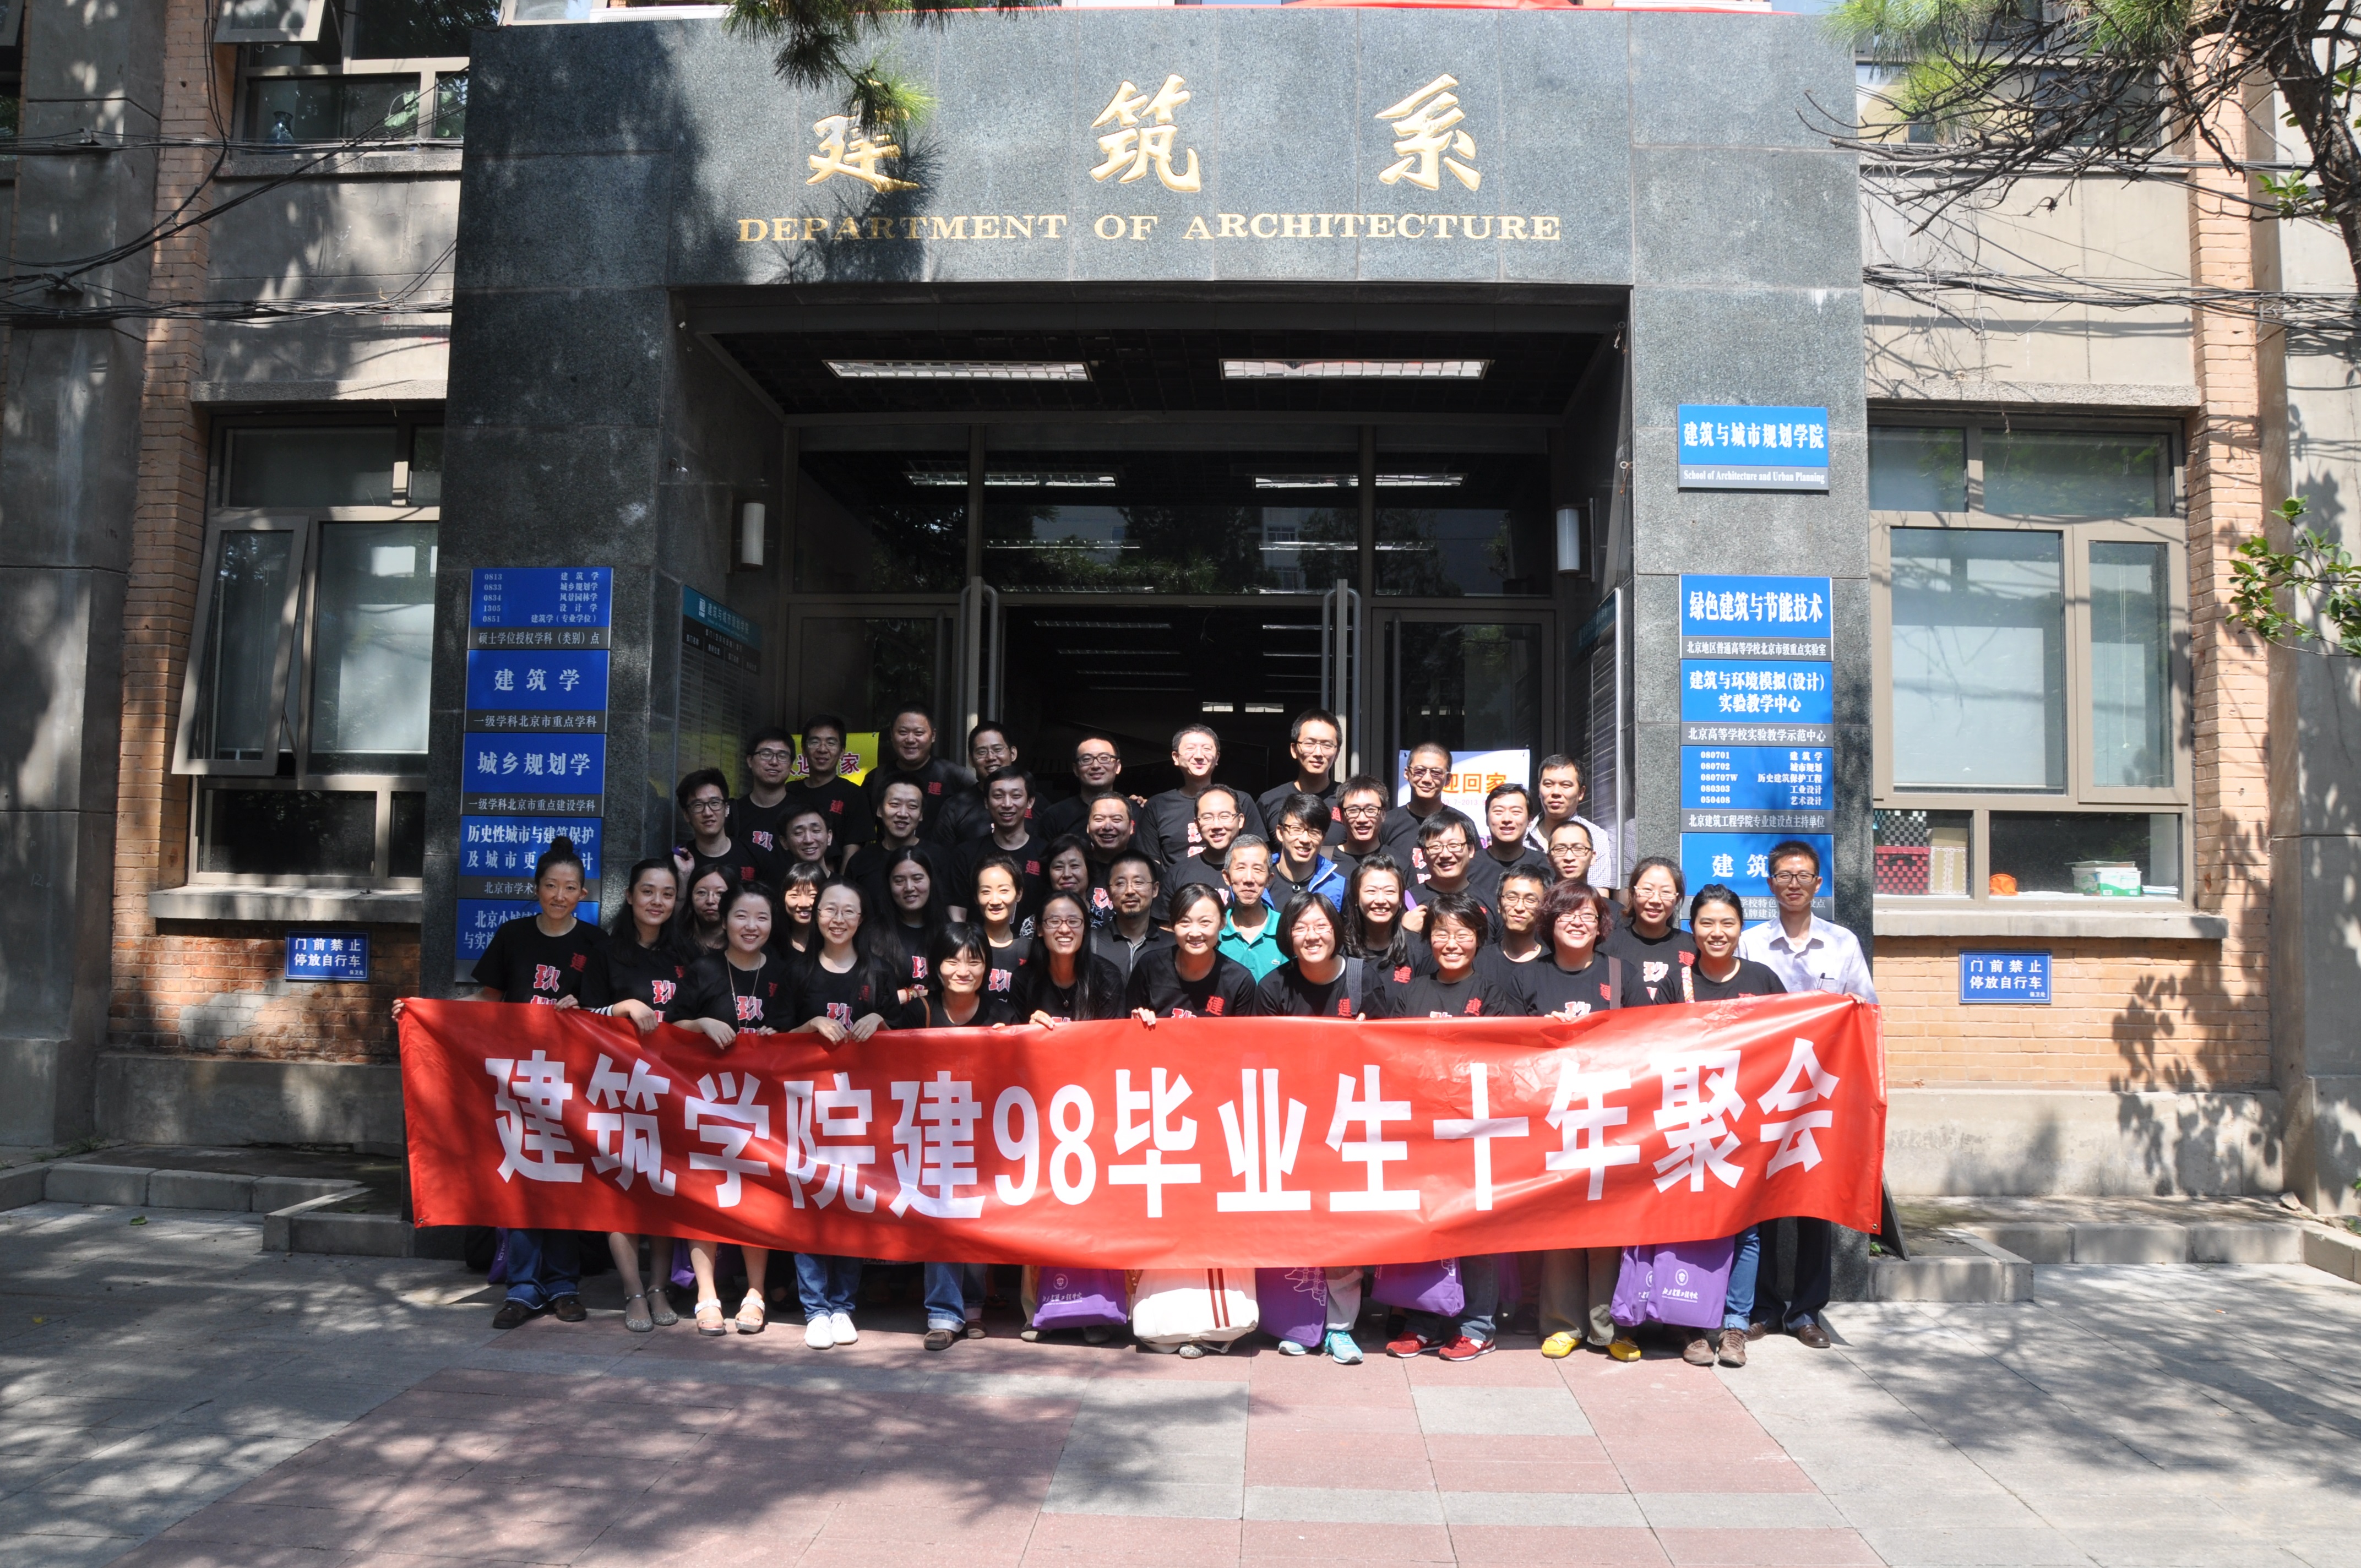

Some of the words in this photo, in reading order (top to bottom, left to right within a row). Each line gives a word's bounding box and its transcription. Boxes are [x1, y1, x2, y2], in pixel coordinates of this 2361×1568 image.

[736, 214, 1068, 243] DEPARTMENT
[1094, 214, 1158, 242] OF
[1183, 212, 1562, 242] ARCHITECTURE
[1683, 421, 1824, 449] 建筑与城市规划学院
[1684, 470, 1706, 480] School
[1707, 470, 1715, 480] of
[1716, 470, 1758, 481] Architecture
[1759, 471, 1771, 481] and
[1773, 471, 1794, 482] Urban
[1796, 472, 1825, 484] Planning
[561, 571, 599, 581] 建筑学
[560, 582, 599, 591] 城乡规划学
[559, 592, 598, 602] 风景园林学
[1689, 591, 1823, 623] 绿色建筑与节能技术
[1687, 641, 1827, 656] 北京地区普通高等学校北京市级重点实验室
[494, 668, 580, 692] 建筑学
[1689, 670, 1824, 692] 建筑与环境模拟(设计)
[1718, 693, 1801, 713] 实验教学中心
[474, 714, 597, 728] 一级学科北京市重点学科
[1688, 727, 1826, 743] 北京高等学校实验教学示范中心
[477, 752, 591, 775] 城乡规划学
[1700, 751, 1730, 759] 080701
[1790, 751, 1823, 761] 建筑学
[1700, 762, 1731, 770] 080702
[1789, 763, 1823, 772] 城市规划
[1758, 773, 1823, 783] 历史建筑保护工程
[928, 781, 942, 795] 建
[1700, 785, 1731, 793] 080303
[1789, 785, 1823, 794] 工业设计
[469, 797, 595, 812] 一级学科北京市重点建设学科
[830, 799, 844, 814] 建
[1700, 796, 1731, 804] 050408
[1790, 796, 1823, 805] 艺术设计
[1688, 814, 1825, 829] 北京建筑工程学院专业建设点主持单位
[467, 825, 594, 845] 历史性城市与建筑保护
[741, 866, 755, 880] 建
[1025, 860, 1040, 875] 建
[485, 881, 537, 895] 北京市学术
[295, 938, 361, 952] 门前禁止
[294, 953, 361, 968] 停放自行车
[570, 952, 587, 973] 建
[1678, 951, 1696, 967] 建
[1970, 959, 2042, 973] 门前禁止
[533, 964, 561, 992] 玖
[1394, 965, 1412, 983] 建
[1970, 975, 2042, 989] 停放自行车
[737, 995, 764, 1021] 玖
[1205, 995, 1226, 1016] 建
[1465, 997, 1482, 1016] 建
[484, 1037, 1840, 1219] 建筑学院建98毕业生十年聚会
